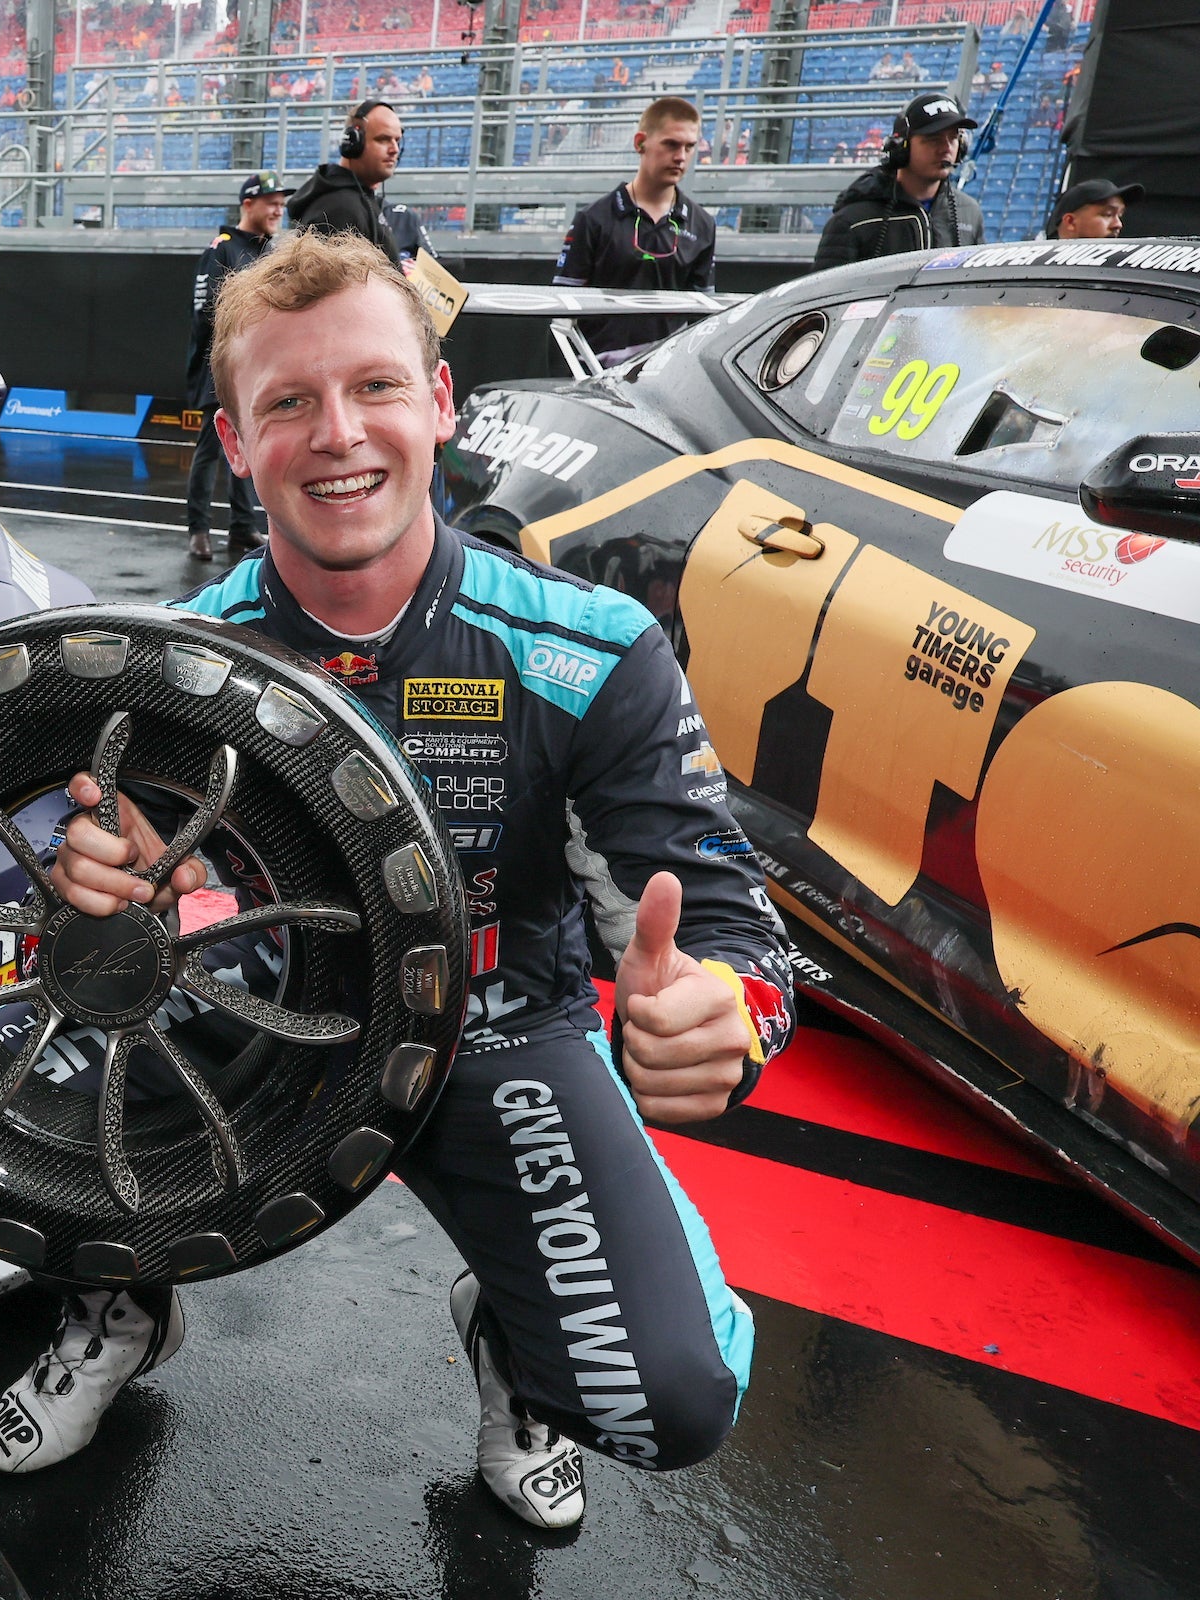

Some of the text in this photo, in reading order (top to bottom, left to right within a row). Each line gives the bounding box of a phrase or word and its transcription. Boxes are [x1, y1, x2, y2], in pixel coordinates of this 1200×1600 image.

[963, 245, 1053, 268] COOPER
[868, 359, 960, 440] 99
[1032, 521, 1120, 562] MSS
[1061, 558, 1128, 587] security
[925, 601, 1011, 664] YOUNG
[527, 647, 597, 687] OMP
[912, 624, 996, 689] TIMERS
[408, 682, 499, 696] NATIONAL
[904, 654, 984, 713] garage
[412, 700, 495, 714] STORAGE
[403, 739, 500, 758] COMPLETE
[436, 775, 505, 793] QUAD
[436, 793, 505, 811] LOCK
[147, 923, 171, 977] TROPHY
[403, 967, 414, 993] 2024
[116, 1009, 145, 1024] GRAND
[493, 1079, 583, 1194] GIVES
[531, 1192, 614, 1296] YOU
